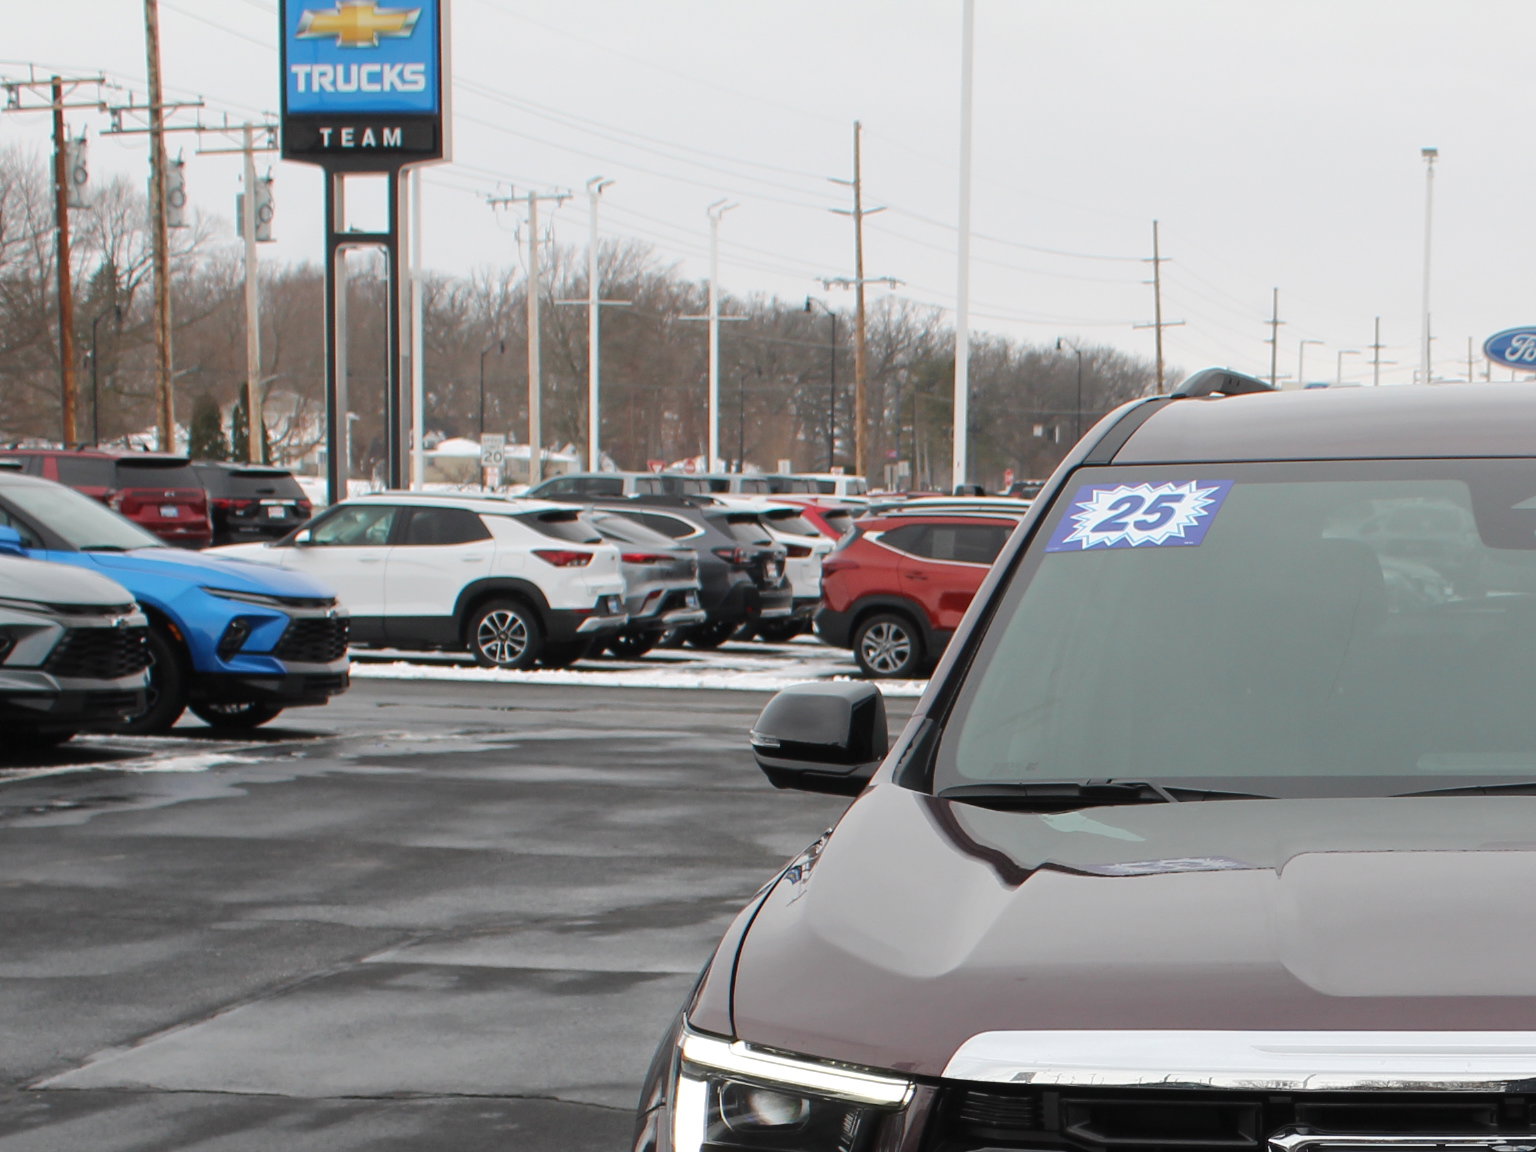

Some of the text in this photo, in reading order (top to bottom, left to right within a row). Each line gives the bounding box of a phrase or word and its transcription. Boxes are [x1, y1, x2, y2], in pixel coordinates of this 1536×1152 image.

[291, 63, 426, 93] TRUCKS
[319, 127, 402, 148] TEAM
[1090, 493, 1186, 533] 25
